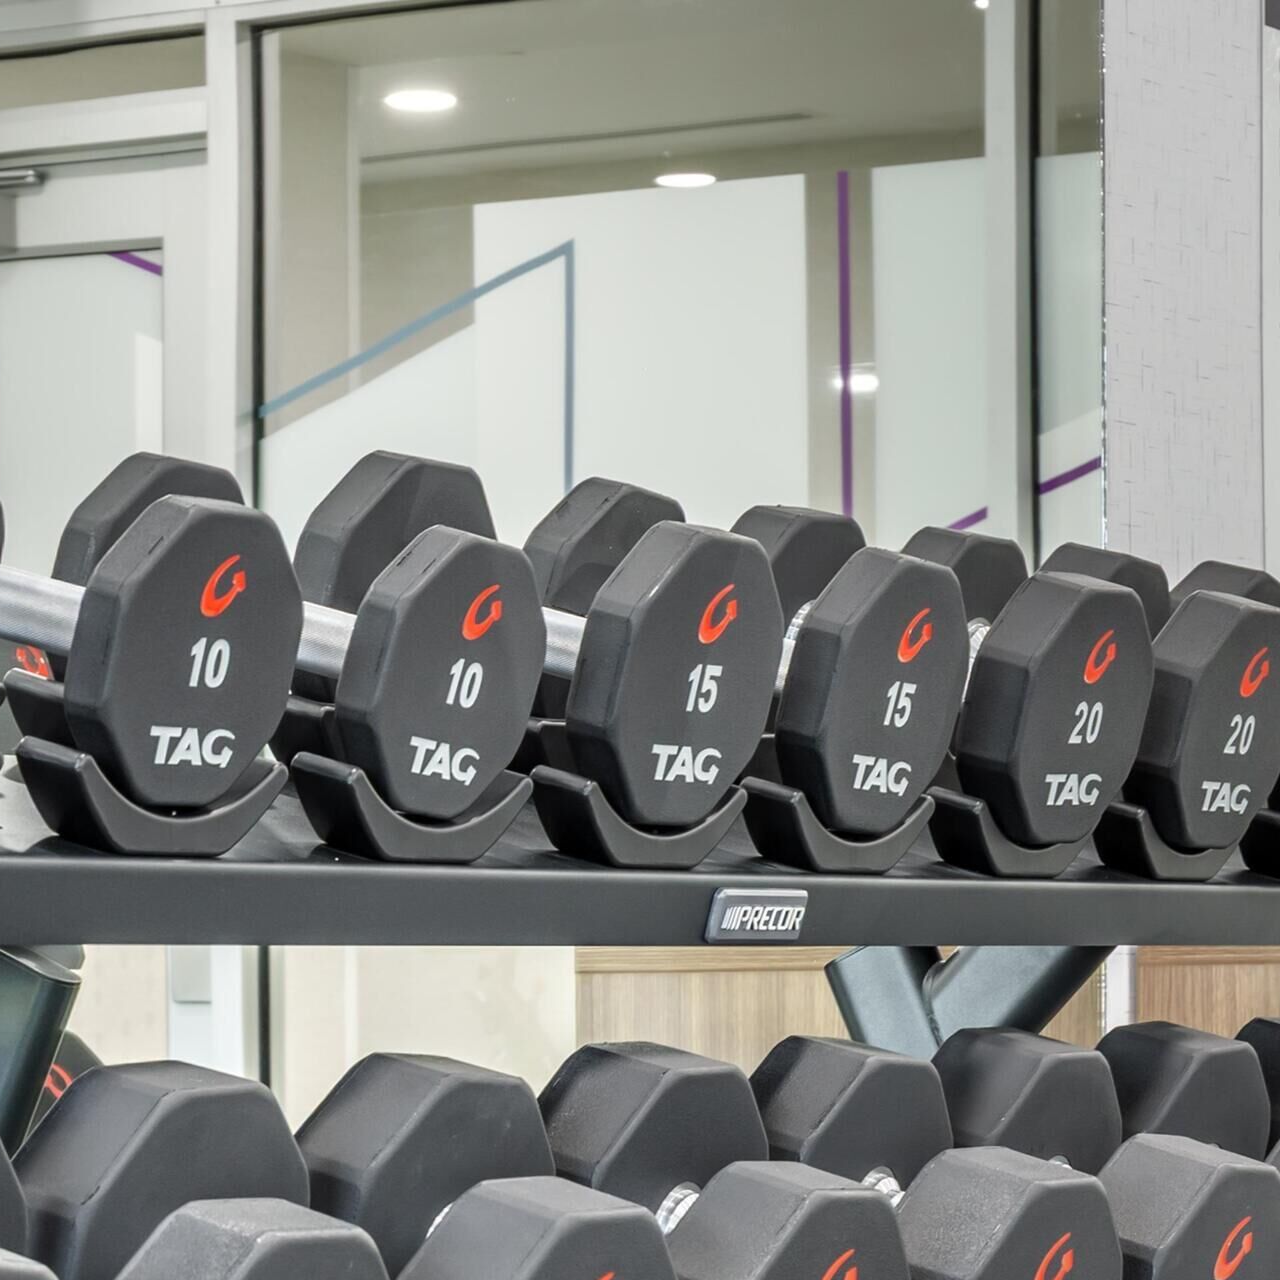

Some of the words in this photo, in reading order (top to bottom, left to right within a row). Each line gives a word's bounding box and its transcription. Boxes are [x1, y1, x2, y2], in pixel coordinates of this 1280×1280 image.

[189, 638, 230, 688] 10
[446, 659, 483, 708] 10
[686, 664, 723, 712] 15
[884, 681, 916, 727] 15
[1068, 701, 1103, 744] 20
[1224, 715, 1255, 755] 20
[150, 726, 235, 768] TAG
[410, 736, 480, 785] TAG
[652, 744, 722, 784] TAG
[853, 754, 911, 796] TAG
[1045, 774, 1102, 805] TAG
[1202, 781, 1251, 814] TAG
[734, 905, 806, 931] PRECOR
